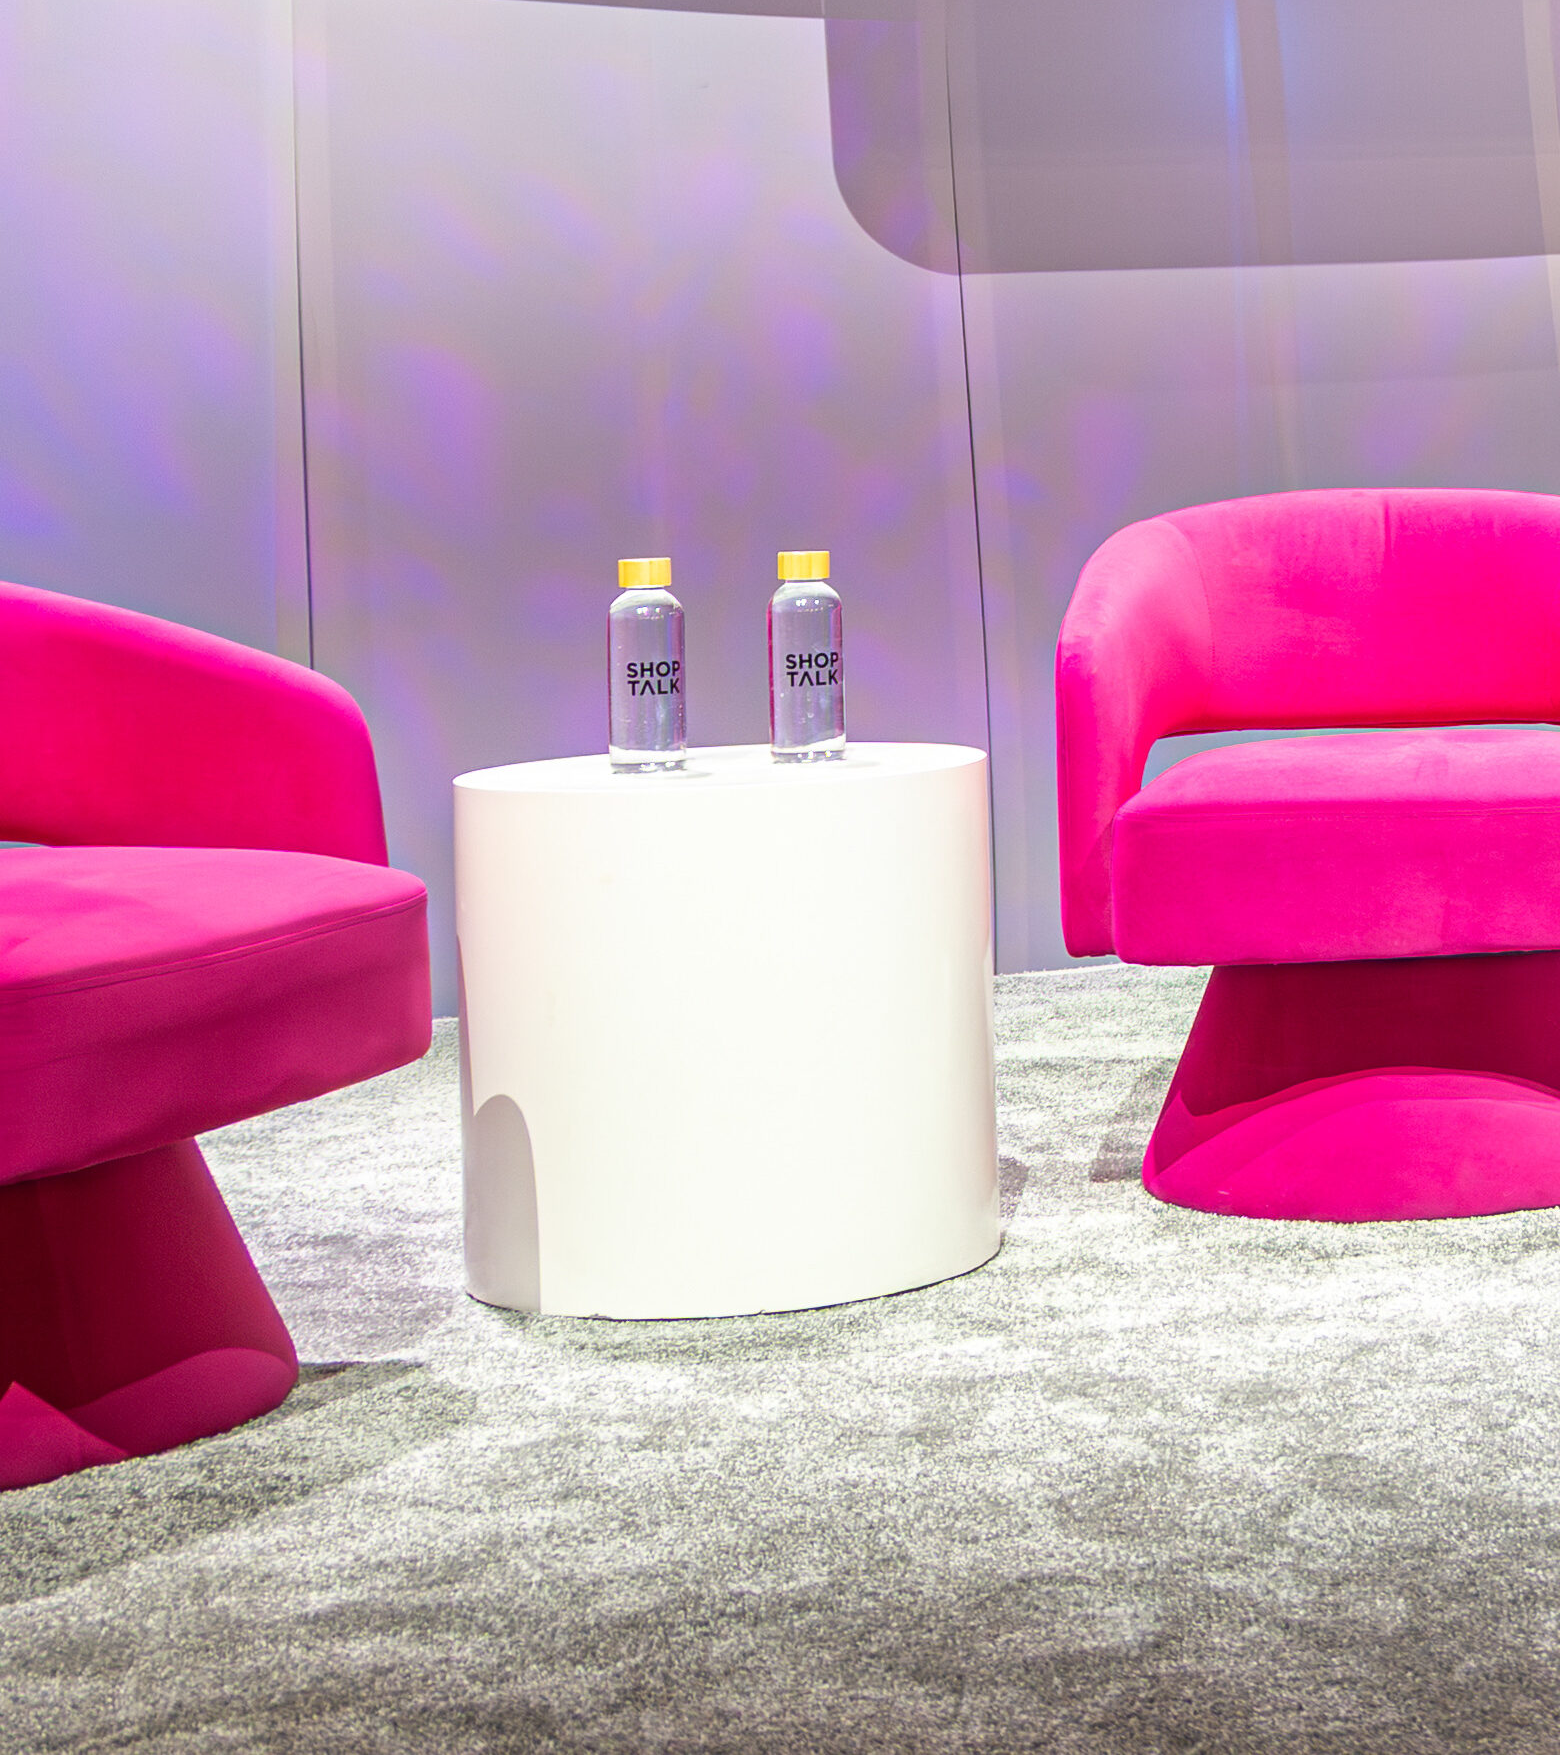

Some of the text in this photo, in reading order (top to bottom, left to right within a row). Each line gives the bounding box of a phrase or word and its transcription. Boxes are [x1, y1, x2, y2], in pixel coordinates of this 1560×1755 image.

[785, 652, 839, 669] SHOP
[627, 661, 680, 679] SHOP
[786, 668, 839, 687] TALK
[627, 678, 680, 696] TALK
